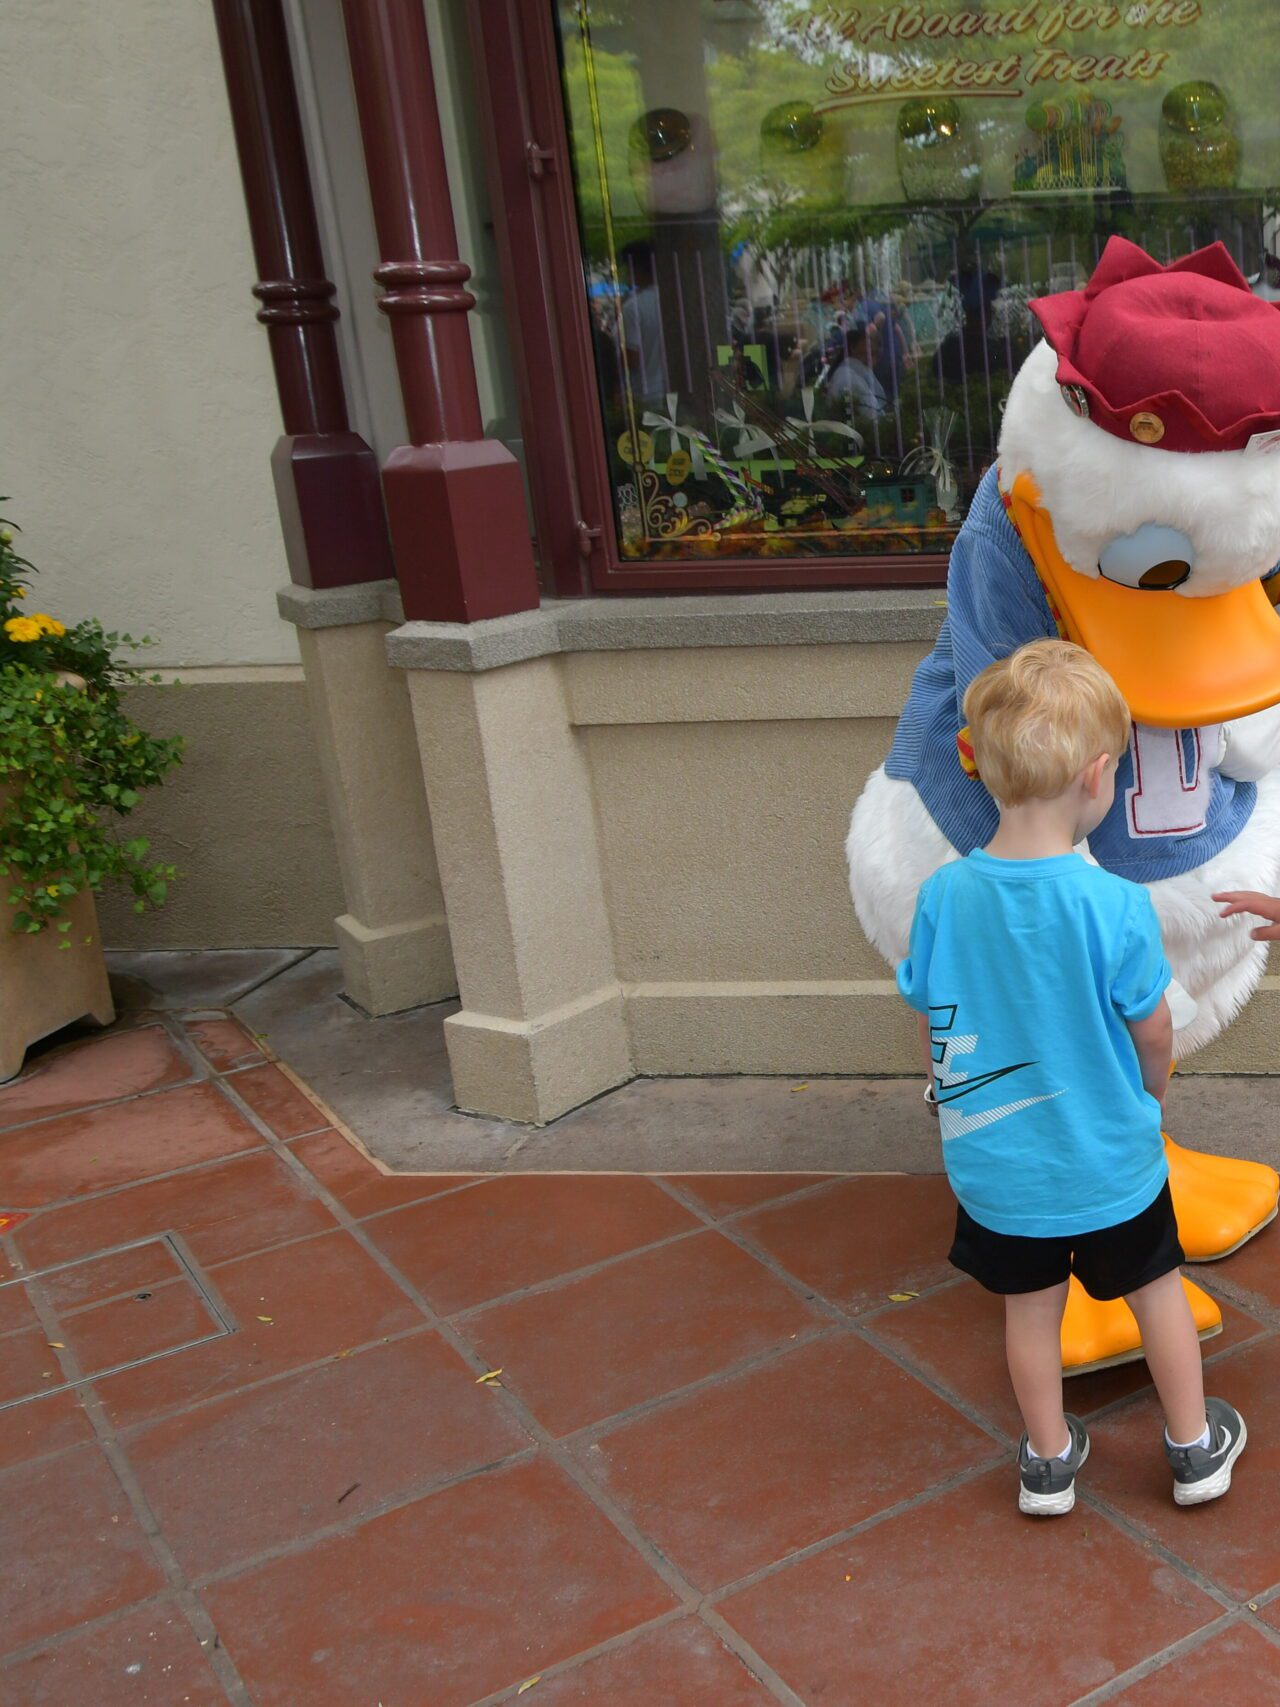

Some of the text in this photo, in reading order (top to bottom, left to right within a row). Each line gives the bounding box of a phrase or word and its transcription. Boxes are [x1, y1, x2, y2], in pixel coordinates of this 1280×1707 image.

[859, 0, 1040, 44] Aboard
[1036, 0, 1121, 44] for
[1124, 0, 1202, 29] the
[825, 49, 1168, 94] Sweetest Treats
